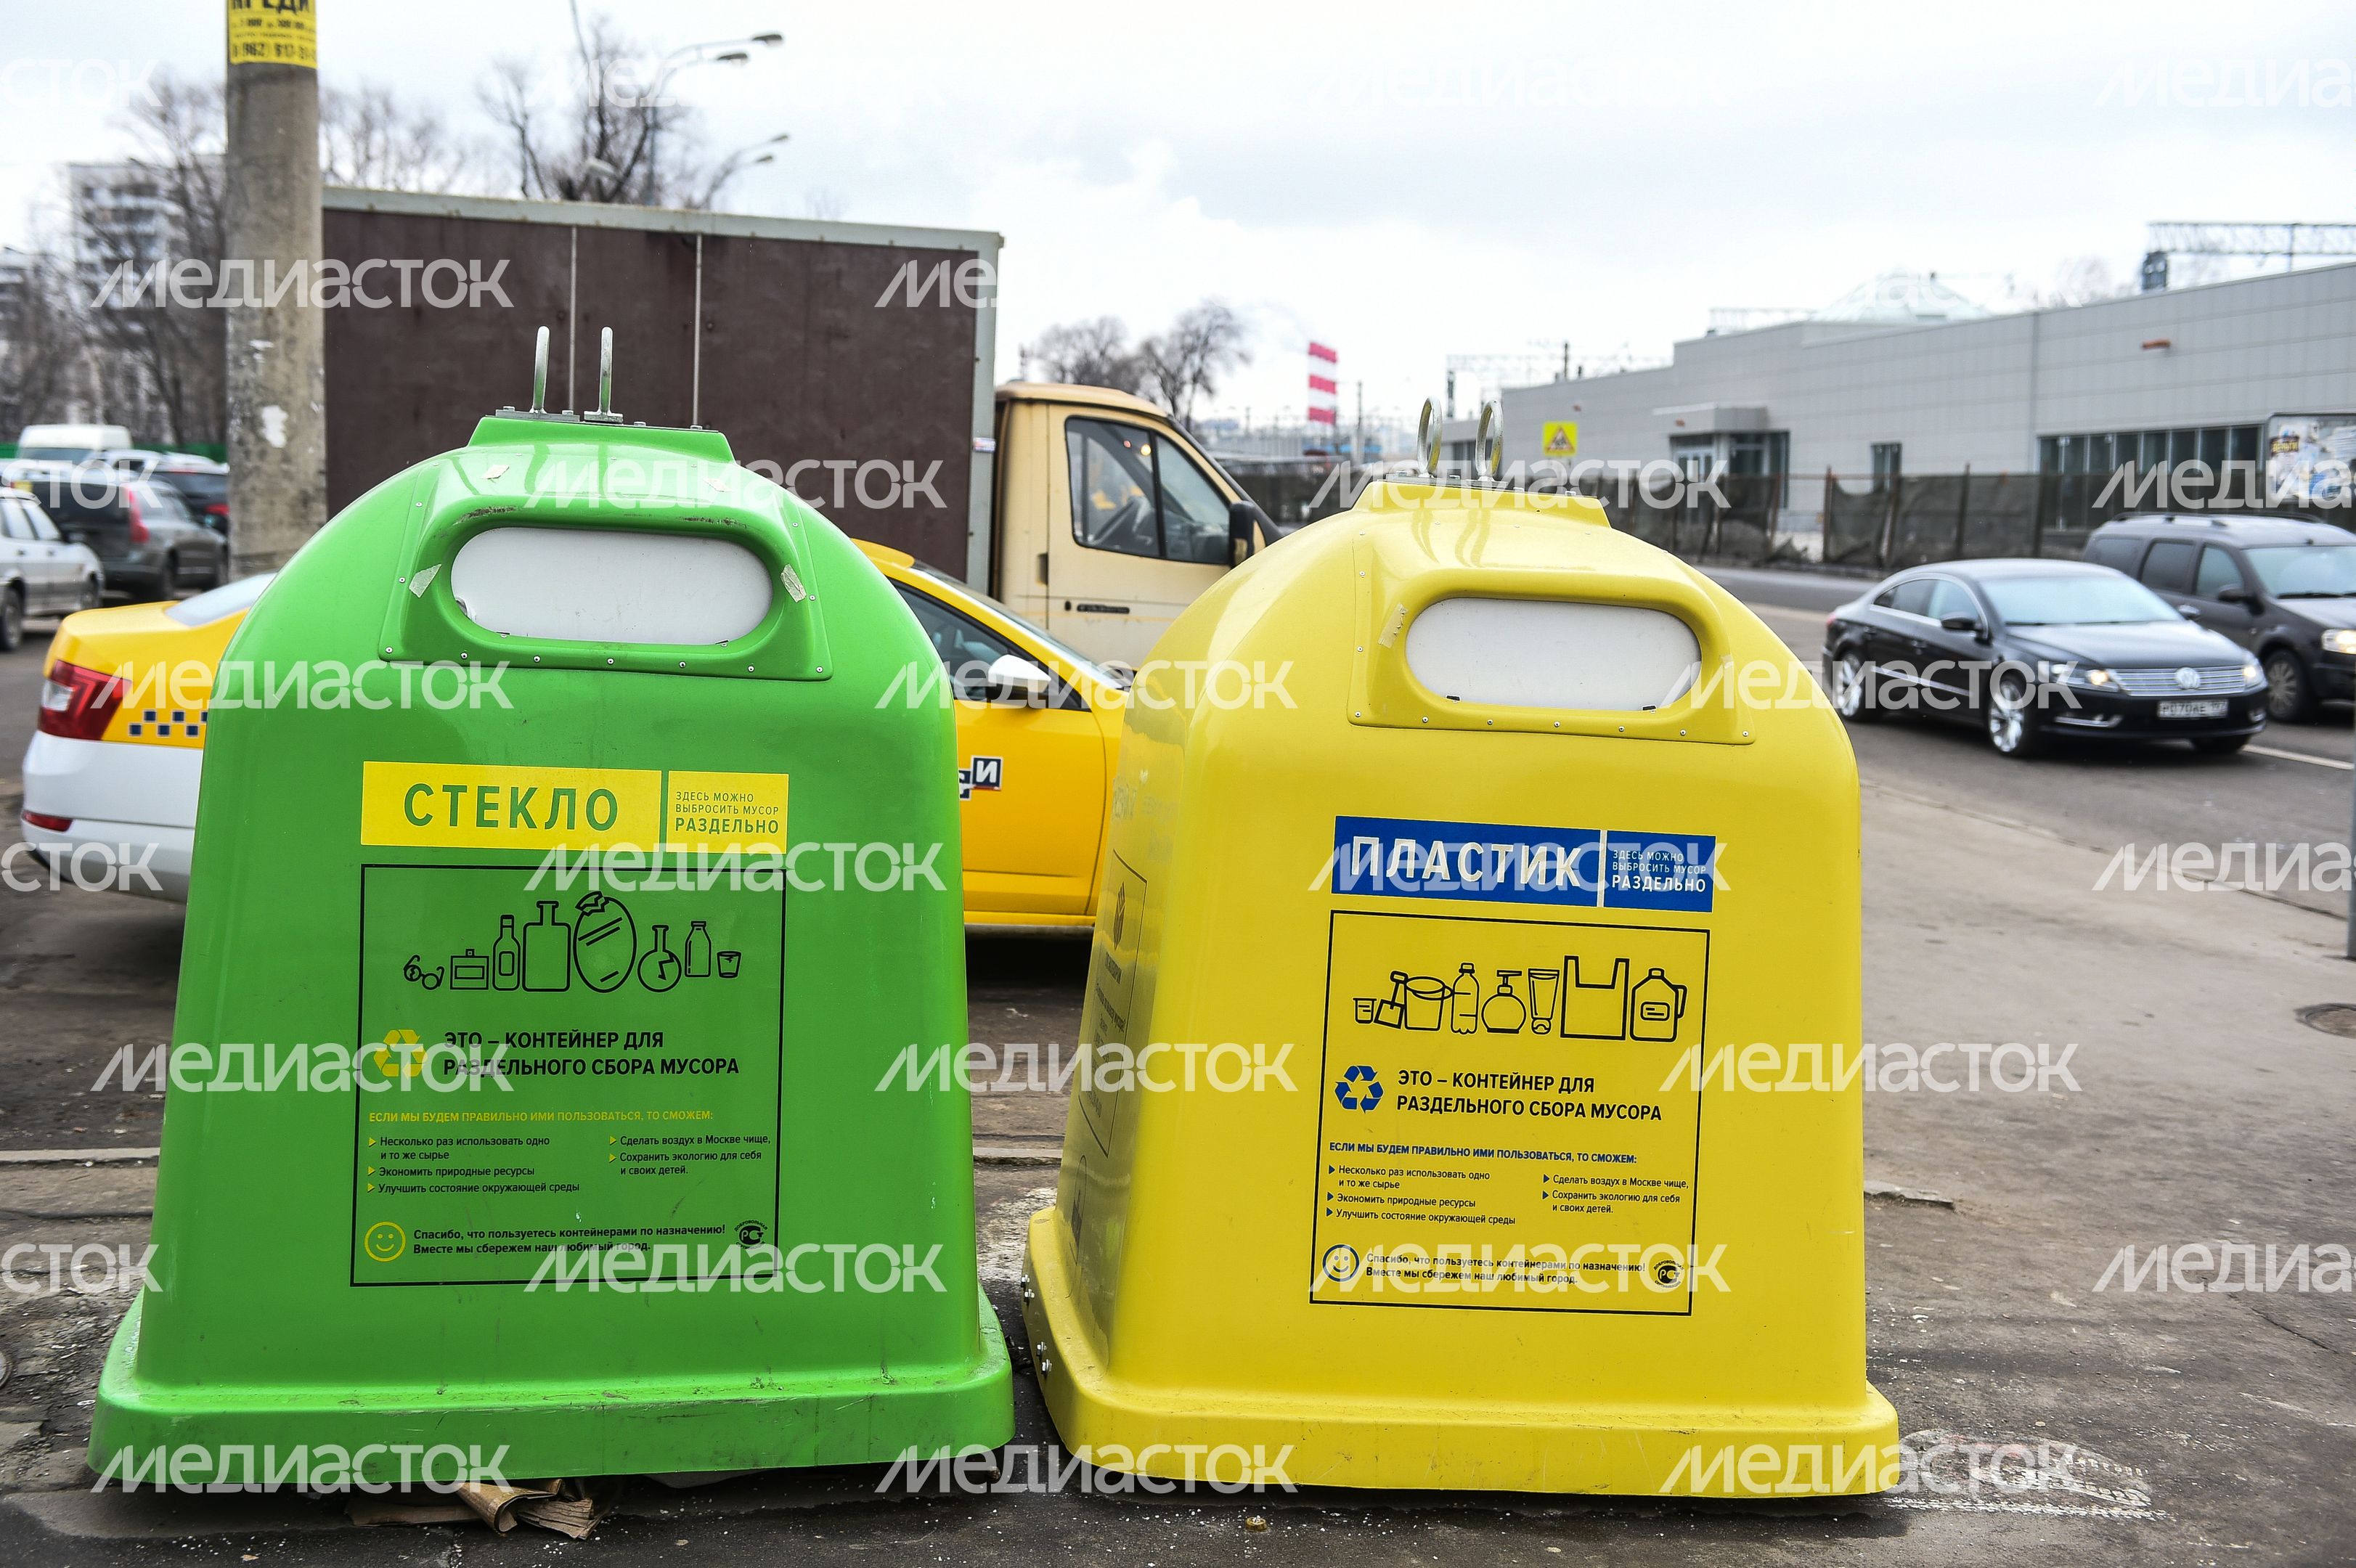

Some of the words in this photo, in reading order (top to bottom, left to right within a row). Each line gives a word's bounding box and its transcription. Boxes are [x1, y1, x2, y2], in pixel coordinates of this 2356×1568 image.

[676, 791, 709, 801] ЗДЕСЬ
[713, 792, 753, 802] МОЖНО
[404, 783, 617, 830] СТЕКЛО
[675, 803, 738, 814] ВЫБРОСИТЬ
[743, 805, 778, 814] МУСОР
[675, 817, 778, 834] РАЗДЕЛЬНО
[1352, 836, 1582, 886] ПЛАСТИК
[1613, 850, 1643, 860] ЗДЕСЬ
[1647, 852, 1684, 862] МОЖНО
[1613, 862, 1670, 873] ВЫБРОСИТЬ
[1674, 865, 1706, 874] МУСОР
[1612, 875, 1705, 892] РАЗДЕЛЬНО
[444, 1032, 482, 1048] ЭТО
[505, 1029, 619, 1048] КОНТЕЙНЕР
[623, 1032, 663, 1050] ДЛЯ
[444, 1059, 586, 1078] РАЗДЕЛЬНОГО
[591, 1058, 655, 1074] СБОРА
[660, 1058, 738, 1074] МУСОРА
[1398, 1069, 1432, 1086] ЭТО
[1452, 1071, 1554, 1090] КОНТЕЙНЕР
[1558, 1077, 1594, 1093] ДЛЯ
[1397, 1095, 1524, 1115] РАЗДЕЛЬНОГО
[1529, 1101, 1586, 1117] СБОРА
[1591, 1103, 1661, 1120] МУСОРА
[369, 1112, 398, 1122] ЕСЛИ
[400, 1112, 419, 1121] МЫ
[423, 1112, 459, 1122] БУДЕМ
[462, 1112, 527, 1121] ПРАВИЛЬНО
[530, 1112, 554, 1121] ИМИ
[646, 1111, 659, 1119] ТО
[662, 1111, 712, 1119] СМОЖЕМ:
[380, 1136, 433, 1146] Несколько
[436, 1138, 453, 1148] раз
[526, 1138, 550, 1146] одно
[620, 1135, 659, 1146] Сделать
[661, 1137, 694, 1146] воздух
[705, 1135, 741, 1143] Москве
[743, 1135, 770, 1144] чище,
[418, 1151, 449, 1161] сырье
[619, 1152, 669, 1163] Сохранить
[720, 1152, 737, 1161] для
[740, 1150, 761, 1159] себя
[1329, 1142, 1355, 1151] ЕСЛИ
[1357, 1143, 1374, 1152] МЫ
[1377, 1144, 1409, 1154] БУДЕМ
[1411, 1146, 1470, 1156] ПРАВИЛЬНО
[1472, 1148, 1494, 1157] ИМИ
[1496, 1149, 1573, 1161] ПОЛЬЗОВАТЬСЯ,
[1576, 1152, 1589, 1161] ТО
[1591, 1153, 1636, 1163] СМОЖЕМ:
[378, 1167, 432, 1176] Экономить
[435, 1168, 491, 1177] природные
[493, 1167, 534, 1177] ресурсы
[658, 1165, 688, 1175] детей.
[1338, 1164, 1385, 1175] Несколько
[1388, 1169, 1403, 1177] раз
[1406, 1169, 1466, 1178] использовать
[1468, 1172, 1490, 1180] одно
[1372, 1180, 1400, 1190] сырье
[1553, 1174, 1588, 1184] Сделать
[1590, 1177, 1620, 1187] воздух
[1629, 1177, 1661, 1186] Москве
[1663, 1180, 1688, 1188] чище,
[378, 1183, 426, 1195] Улучшить
[481, 1182, 546, 1194] окружающей
[549, 1183, 579, 1193] среды
[1337, 1193, 1385, 1203] Экономить
[1387, 1197, 1436, 1206] природные
[1439, 1199, 1475, 1209] ресурсы
[1552, 1189, 1597, 1201] Сохранить
[1599, 1193, 1640, 1201] экологию
[1660, 1193, 1679, 1202] себя
[1586, 1204, 1613, 1214] детей.
[1336, 1208, 1378, 1220] Улучшить
[1428, 1214, 1485, 1224] окружающей
[1488, 1216, 1515, 1225] среды
[413, 1229, 463, 1240] Спасибо,
[488, 1230, 556, 1240] пользуетесь
[559, 1227, 637, 1238] контейнерами
[656, 1224, 725, 1235] назначению!
[413, 1244, 453, 1253] Вместе
[476, 1243, 531, 1254] сбережем
[534, 1244, 557, 1252] наш
[560, 1241, 613, 1251] любимый
[1366, 1253, 1411, 1265] Спасибо,
[1432, 1257, 1493, 1267] пользуетесь
[1496, 1259, 1565, 1270] контейнерами
[1583, 1262, 1644, 1271] назначению!
[1366, 1267, 1401, 1276] Вместе
[1422, 1269, 1470, 1280] сбережем
[1497, 1272, 1544, 1282] любимый
[1546, 1275, 1577, 1284] город.
